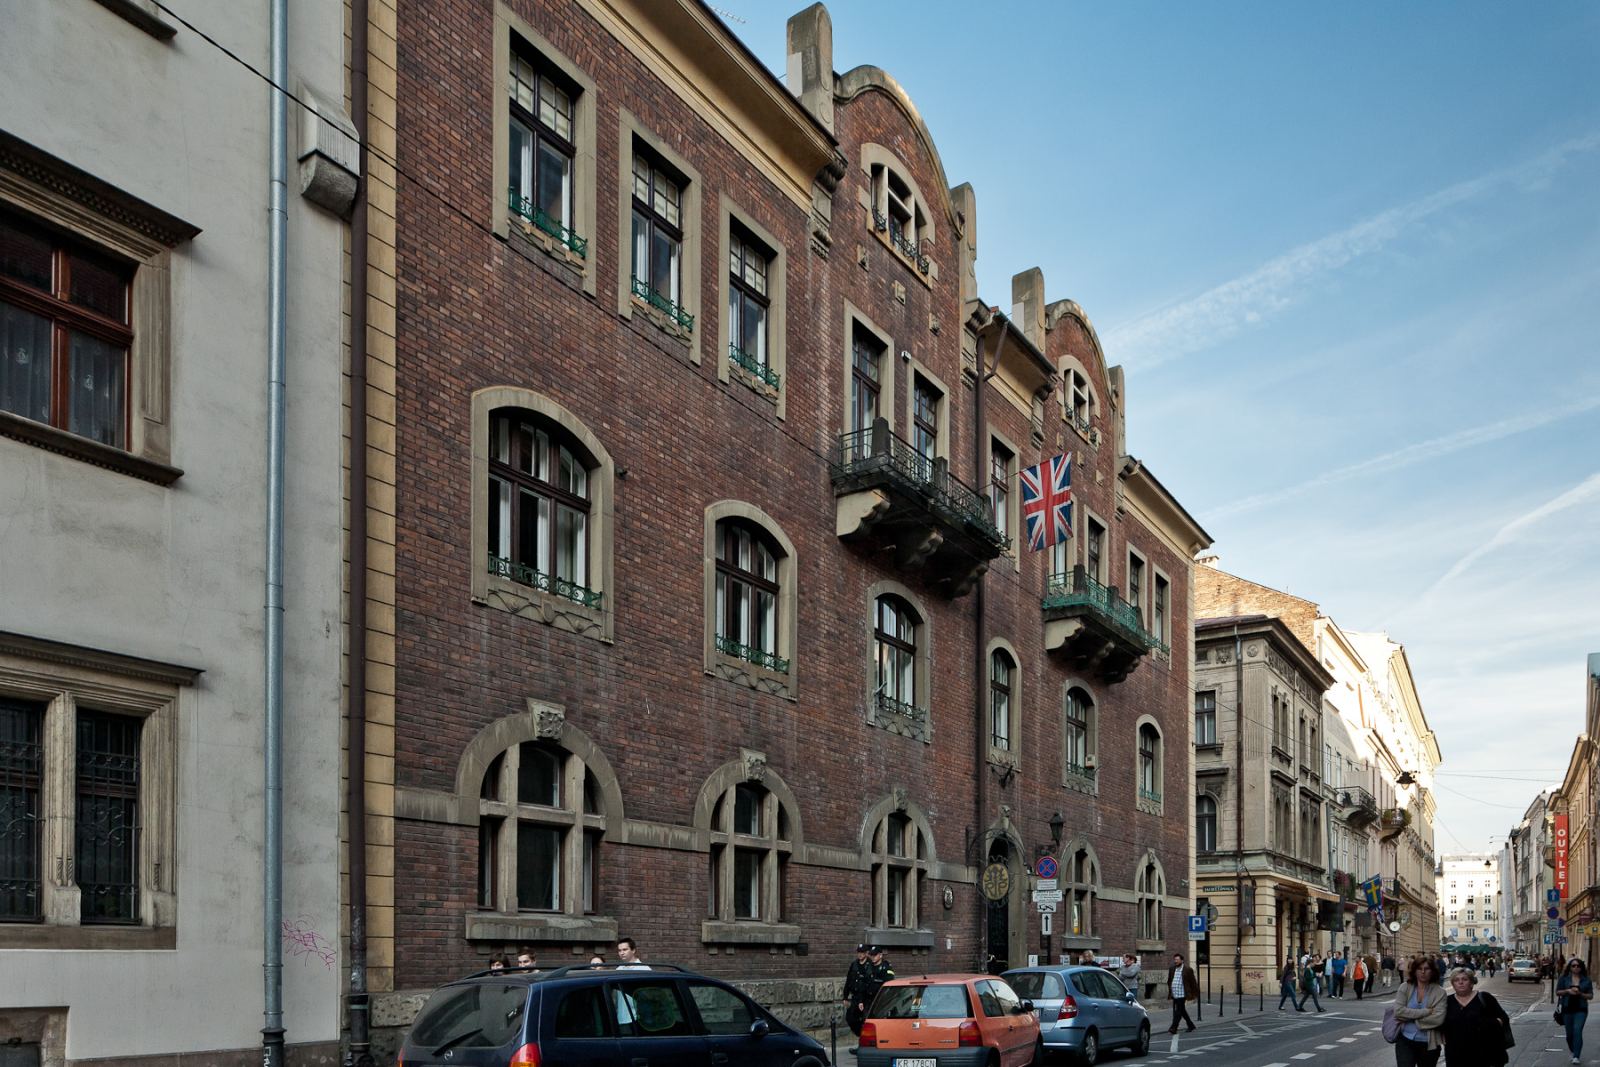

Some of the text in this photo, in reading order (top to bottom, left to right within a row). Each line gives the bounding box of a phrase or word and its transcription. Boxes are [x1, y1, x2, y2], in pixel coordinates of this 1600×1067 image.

[1557, 828, 1567, 890] OUTLET
[1192, 917, 1202, 930] P
[897, 1059, 909, 1067] KR
